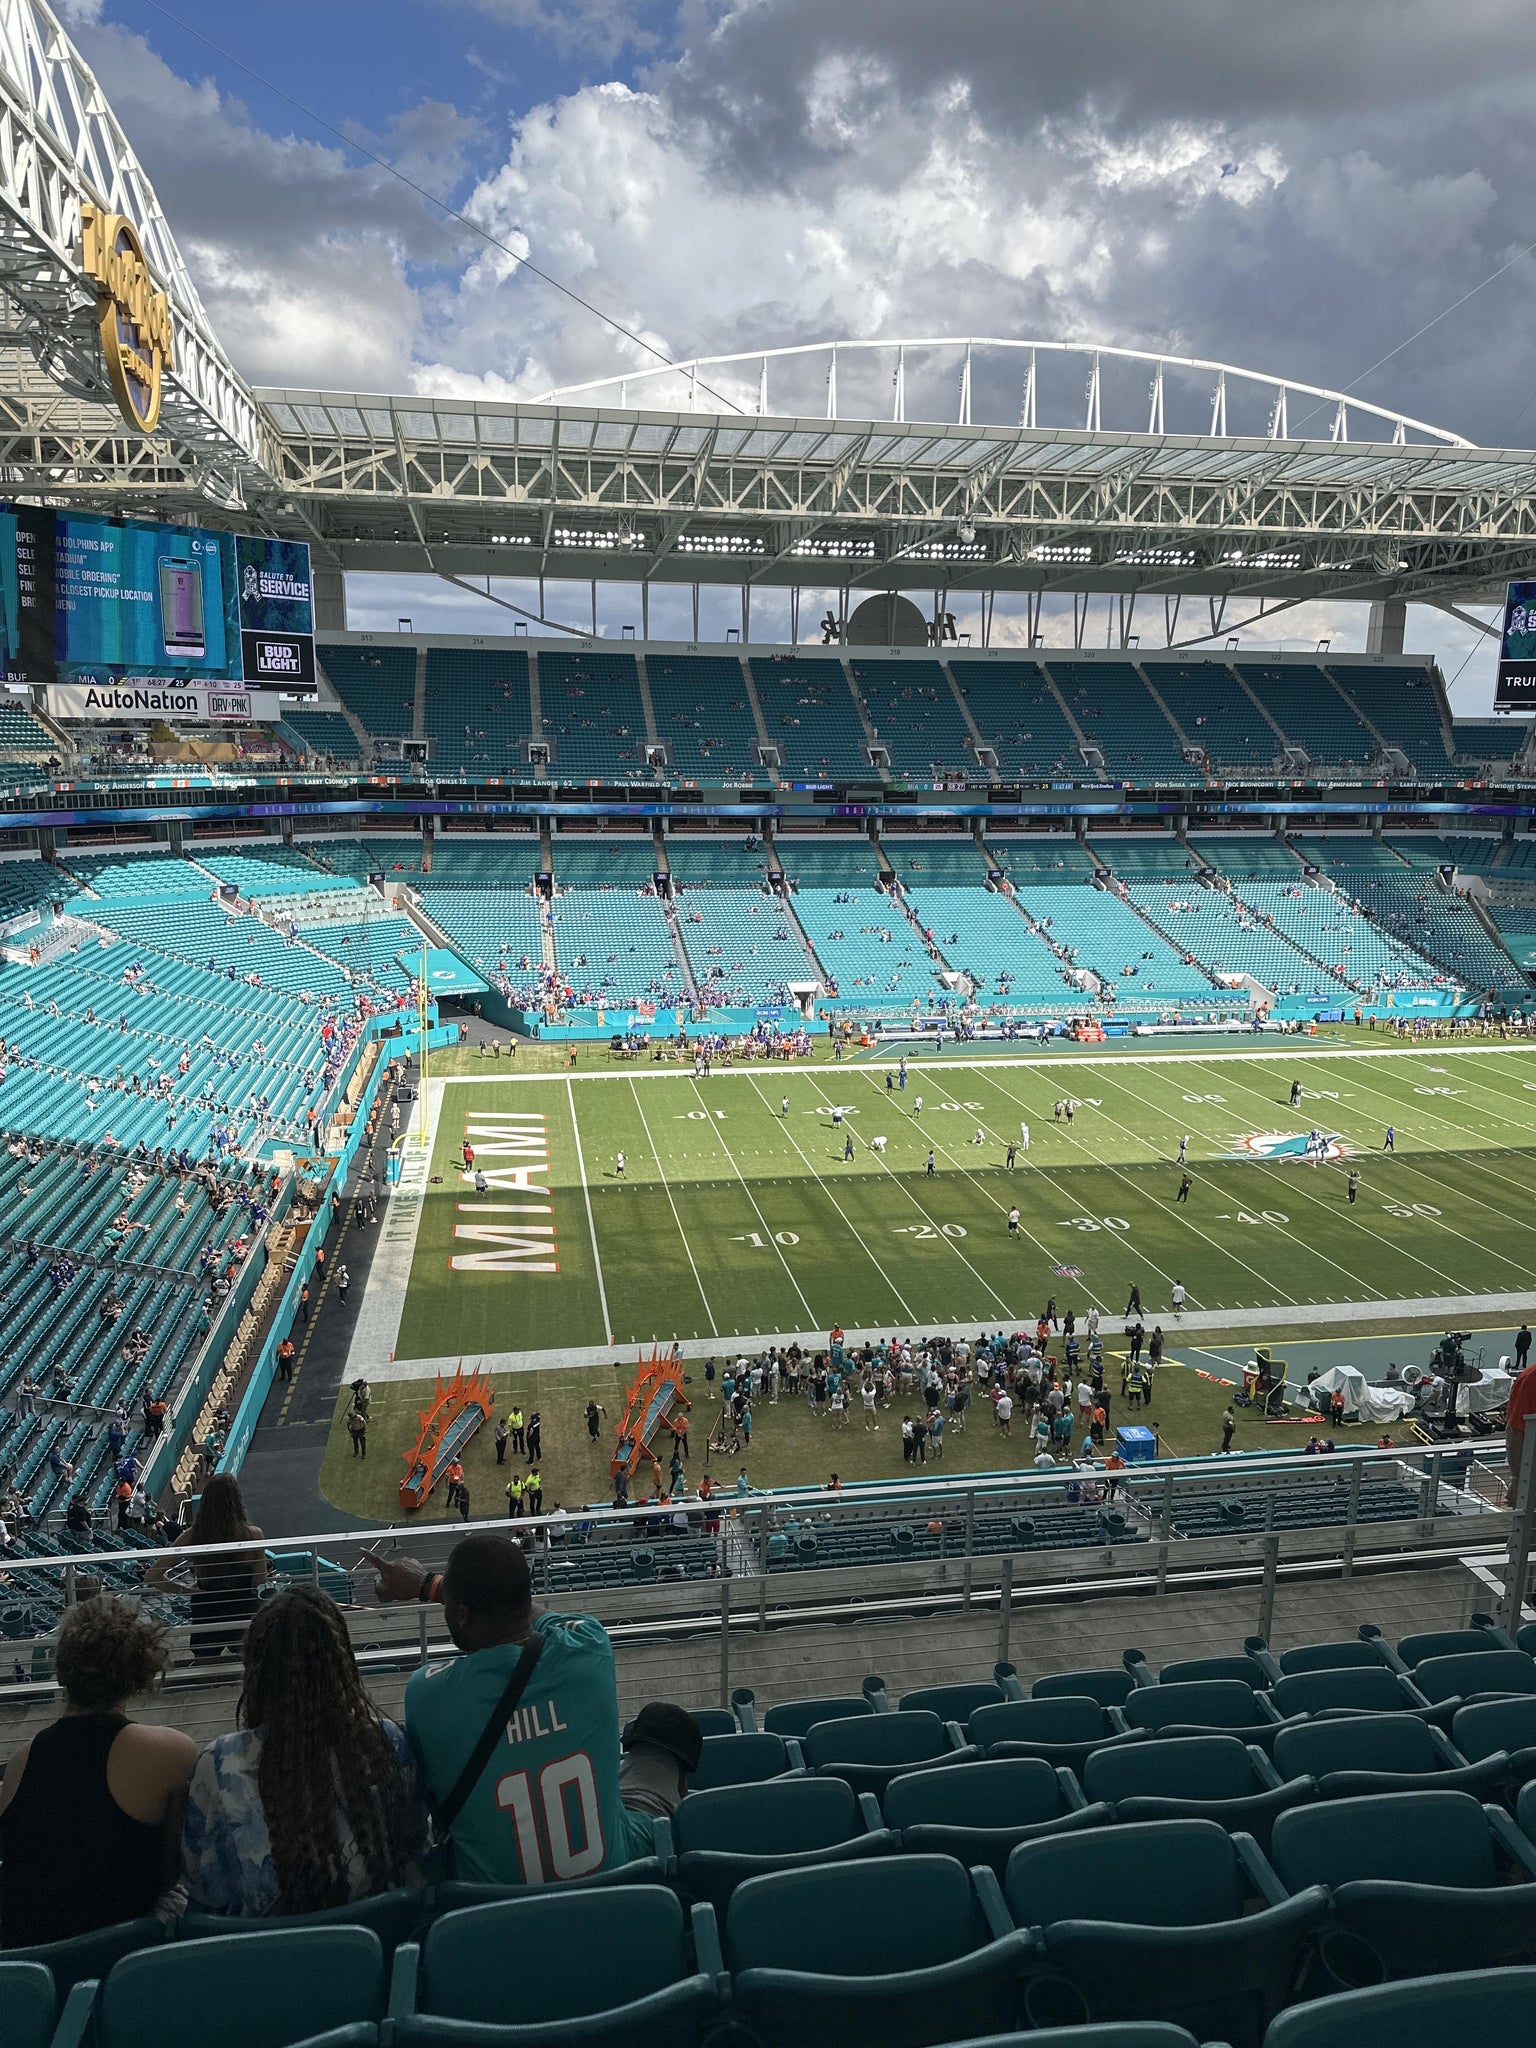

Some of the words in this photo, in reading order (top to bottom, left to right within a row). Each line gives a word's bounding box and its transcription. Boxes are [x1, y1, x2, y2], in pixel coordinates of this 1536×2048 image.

[63, 537, 99, 552] DOLPHINS
[100, 541, 114, 553] APP
[260, 571, 284, 581] SALUTE
[285, 573, 294, 581] TO
[60, 584, 93, 597] CLOSEST
[93, 586, 119, 599] PICKUP
[120, 588, 153, 602] LOCATION
[260, 579, 309, 597] SERVICE
[264, 646, 292, 658] BUD
[260, 657, 298, 670] LIGHT
[7, 672, 27, 682] BUF
[78, 675, 97, 684] MIA
[108, 676, 115, 684] 0
[84, 688, 198, 710] AutoNation
[405, 1150, 428, 1163] OF
[401, 1165, 425, 1184] ALL
[448, 1111, 560, 1273] MIAMI
[389, 1188, 420, 1226] TAKES
[1382, 1203, 1442, 1218] 50
[1069, 1216, 1131, 1231] 30
[1237, 1210, 1290, 1225] 40
[746, 1231, 800, 1247] 10
[908, 1223, 968, 1239] 20
[506, 1700, 567, 1744] HILL
[495, 1750, 607, 1885] 10
